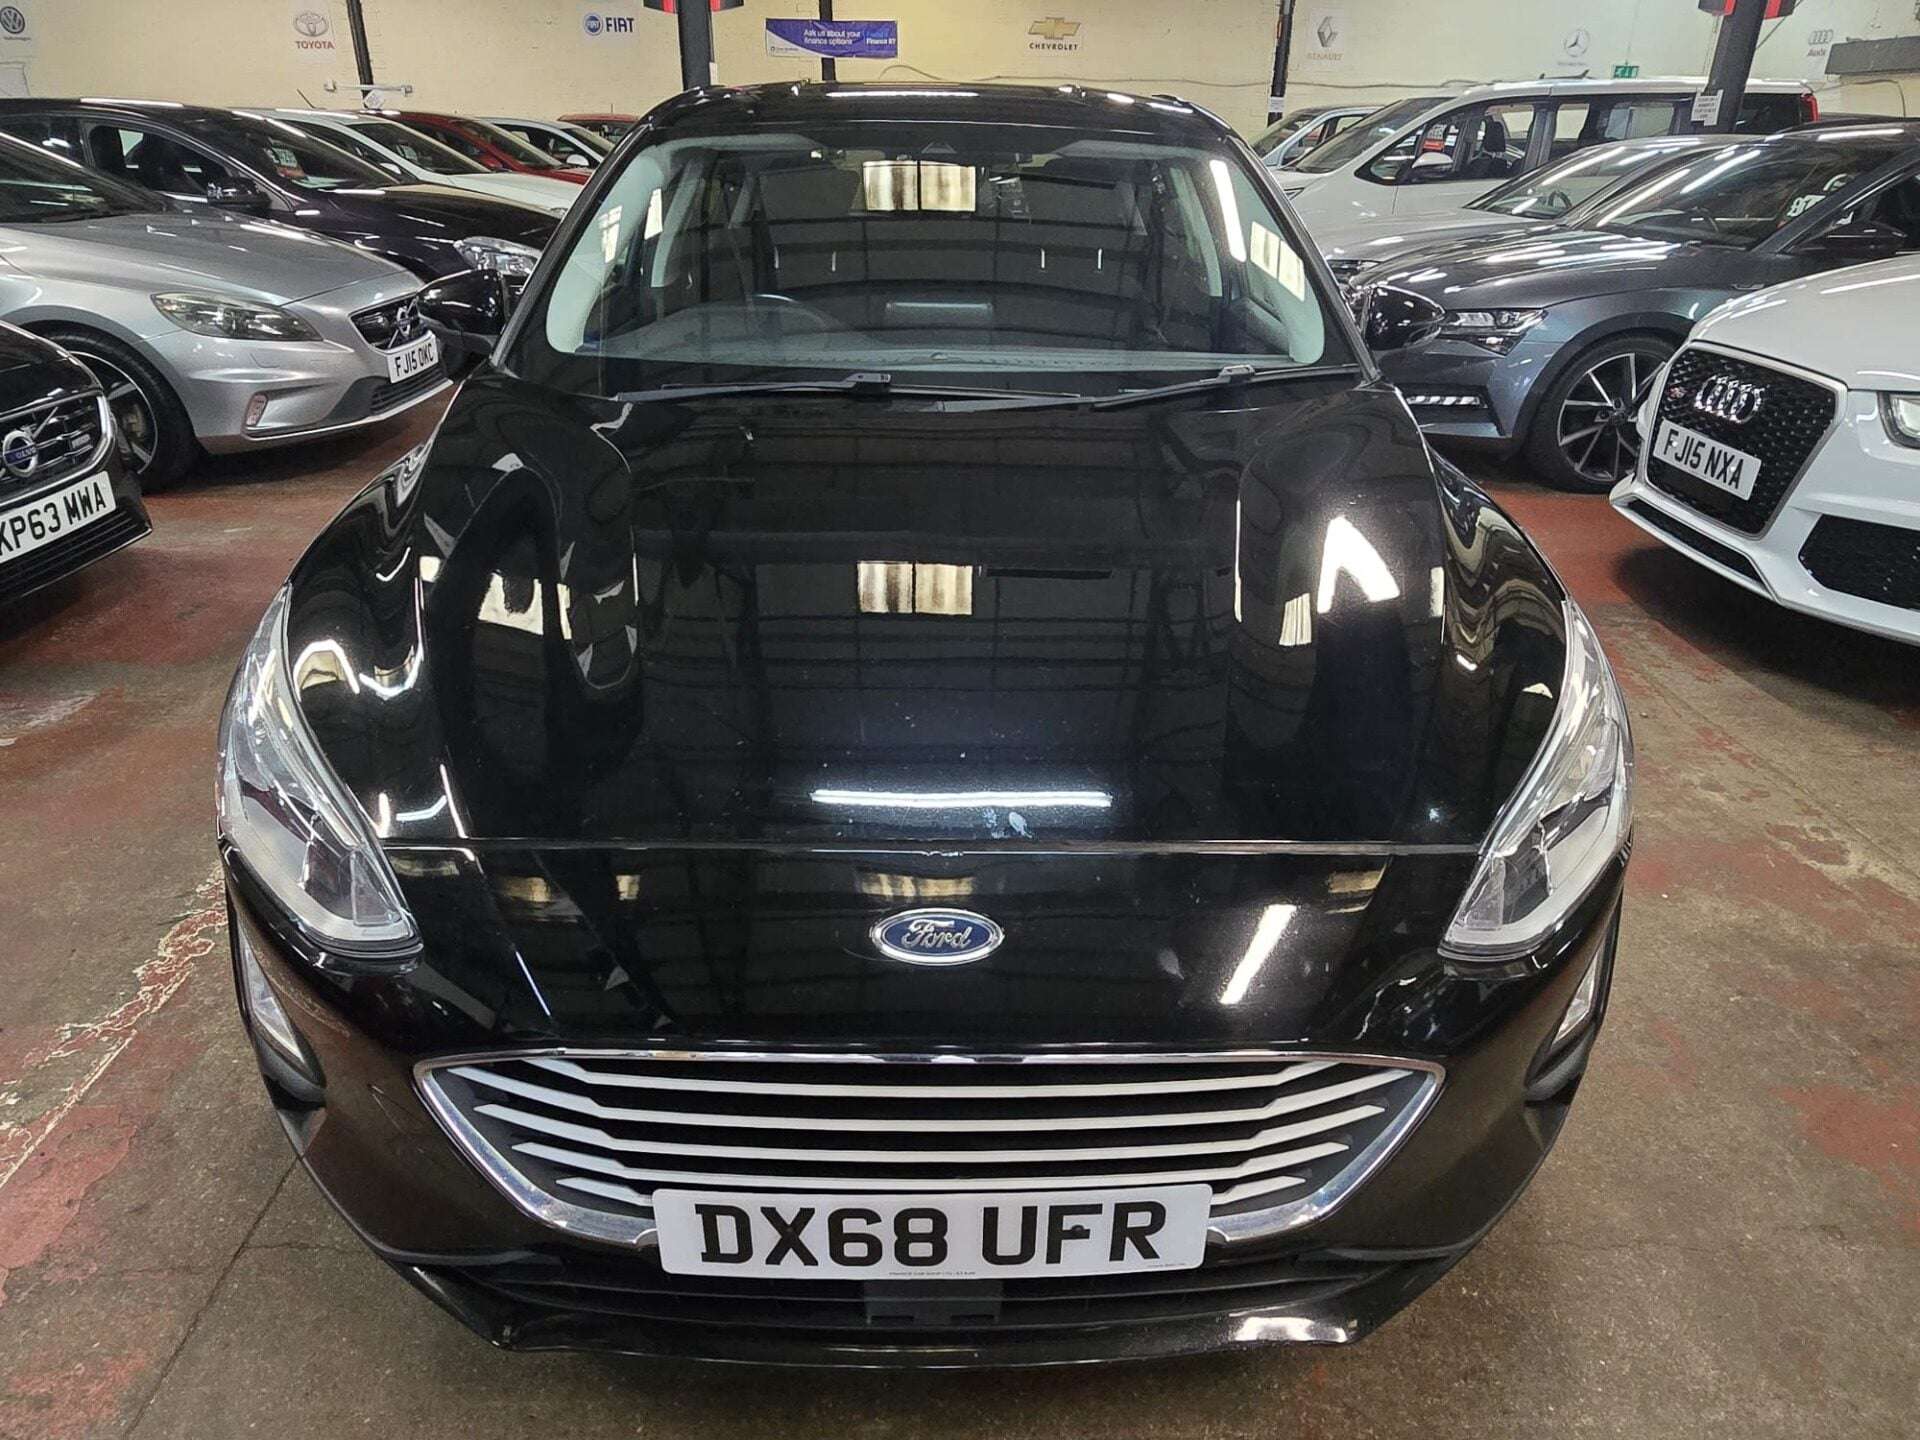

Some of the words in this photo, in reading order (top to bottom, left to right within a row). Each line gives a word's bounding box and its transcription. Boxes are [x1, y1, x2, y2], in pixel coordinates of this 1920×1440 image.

[605, 17, 634, 32] FIAT
[295, 40, 335, 49] TOYOTA
[394, 349, 418, 377] FJ15
[1663, 428, 1706, 470] FJ15
[1704, 446, 1744, 489] NXA
[63, 482, 107, 526] MWA
[901, 918, 973, 949] Ford
[693, 1202, 949, 1267] DX68
[981, 1200, 1167, 1266] UFR
